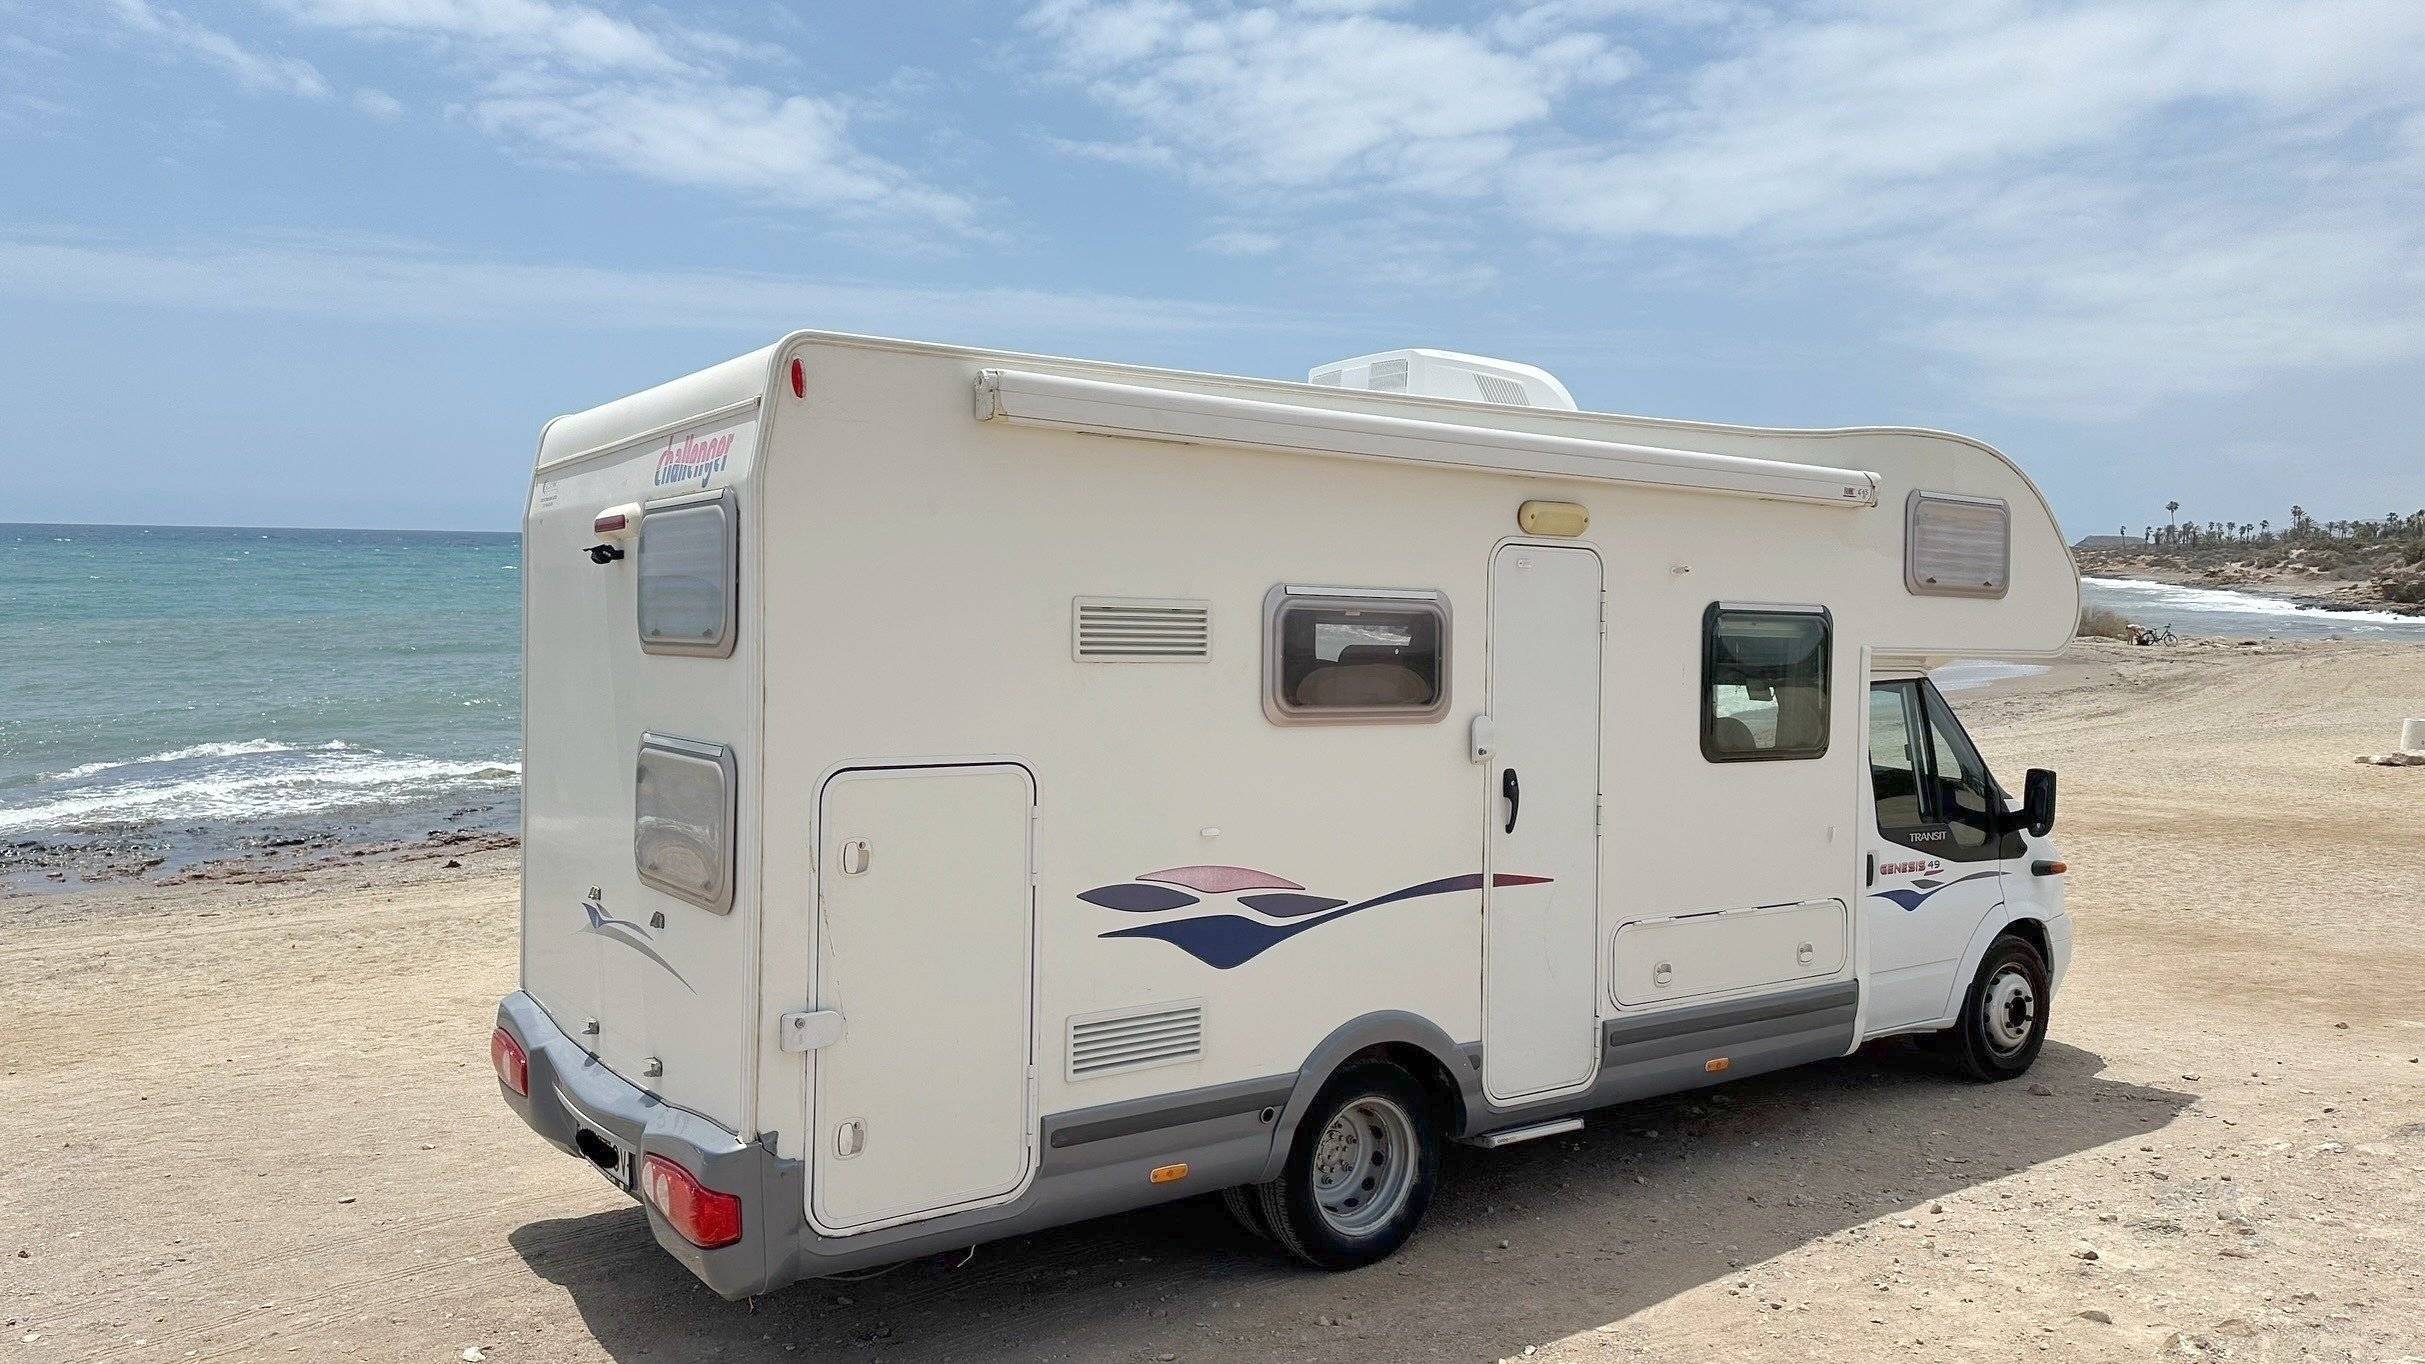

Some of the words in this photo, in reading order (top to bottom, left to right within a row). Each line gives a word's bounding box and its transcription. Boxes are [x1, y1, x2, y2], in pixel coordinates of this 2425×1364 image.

[1909, 831, 1947, 842] TRANSIT
[1880, 860, 1926, 876] GENESIS
[1927, 860, 1941, 870] 49
